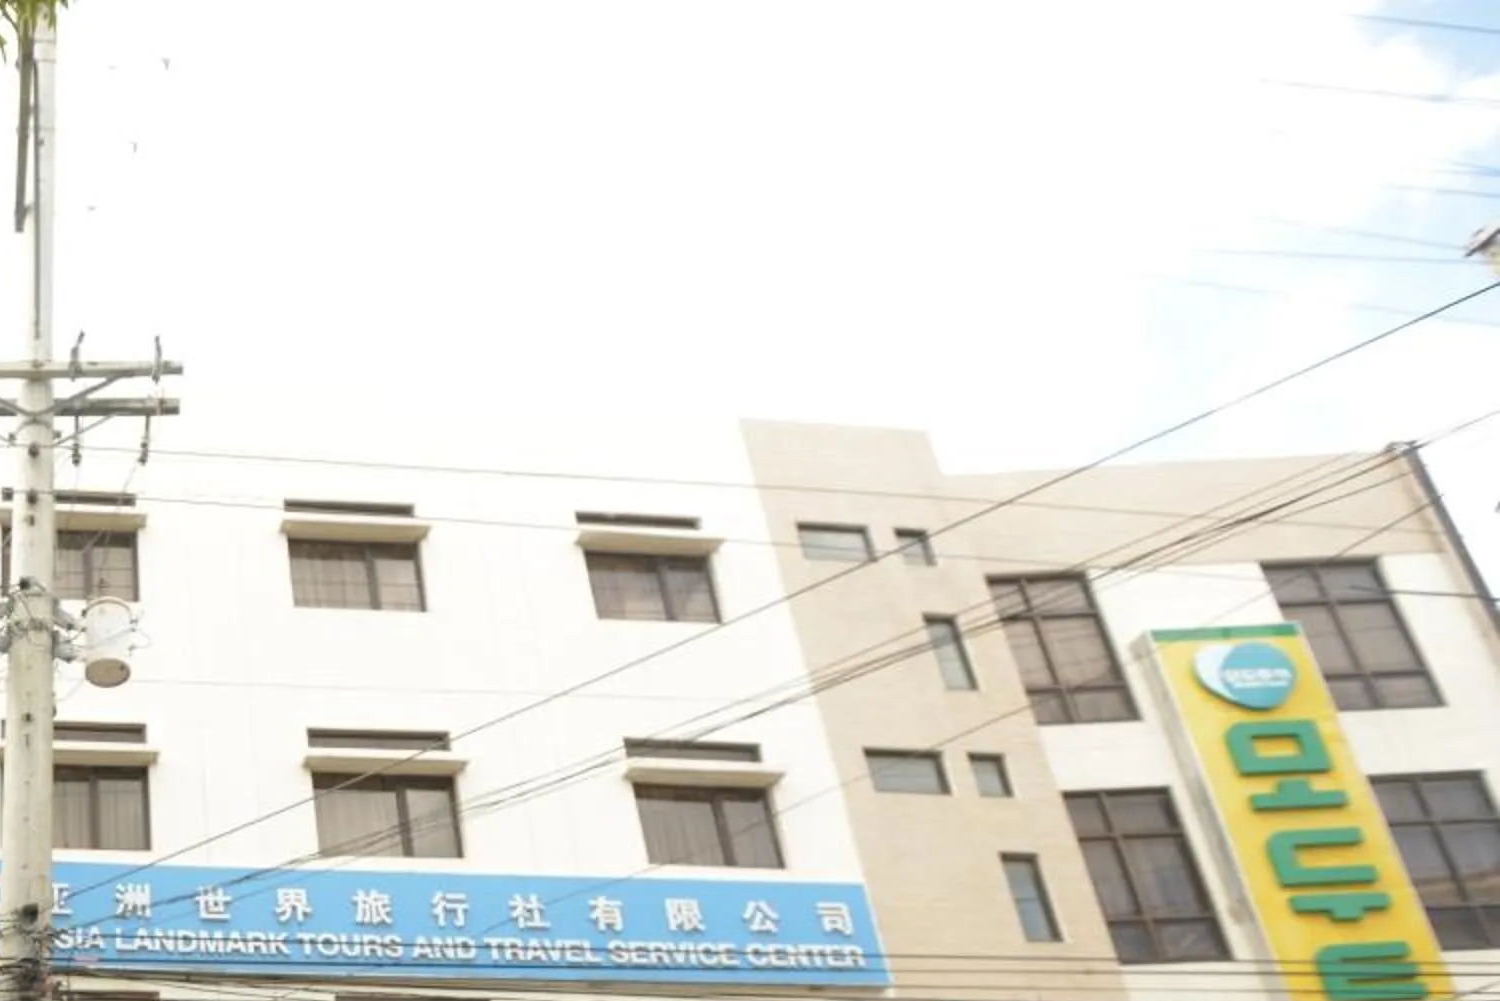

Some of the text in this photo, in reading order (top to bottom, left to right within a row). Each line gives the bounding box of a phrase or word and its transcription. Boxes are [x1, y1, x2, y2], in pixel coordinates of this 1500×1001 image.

[52, 927, 867, 968] SIA LANDMARK TOURS AND TRAVEL SERVICE CENTER
